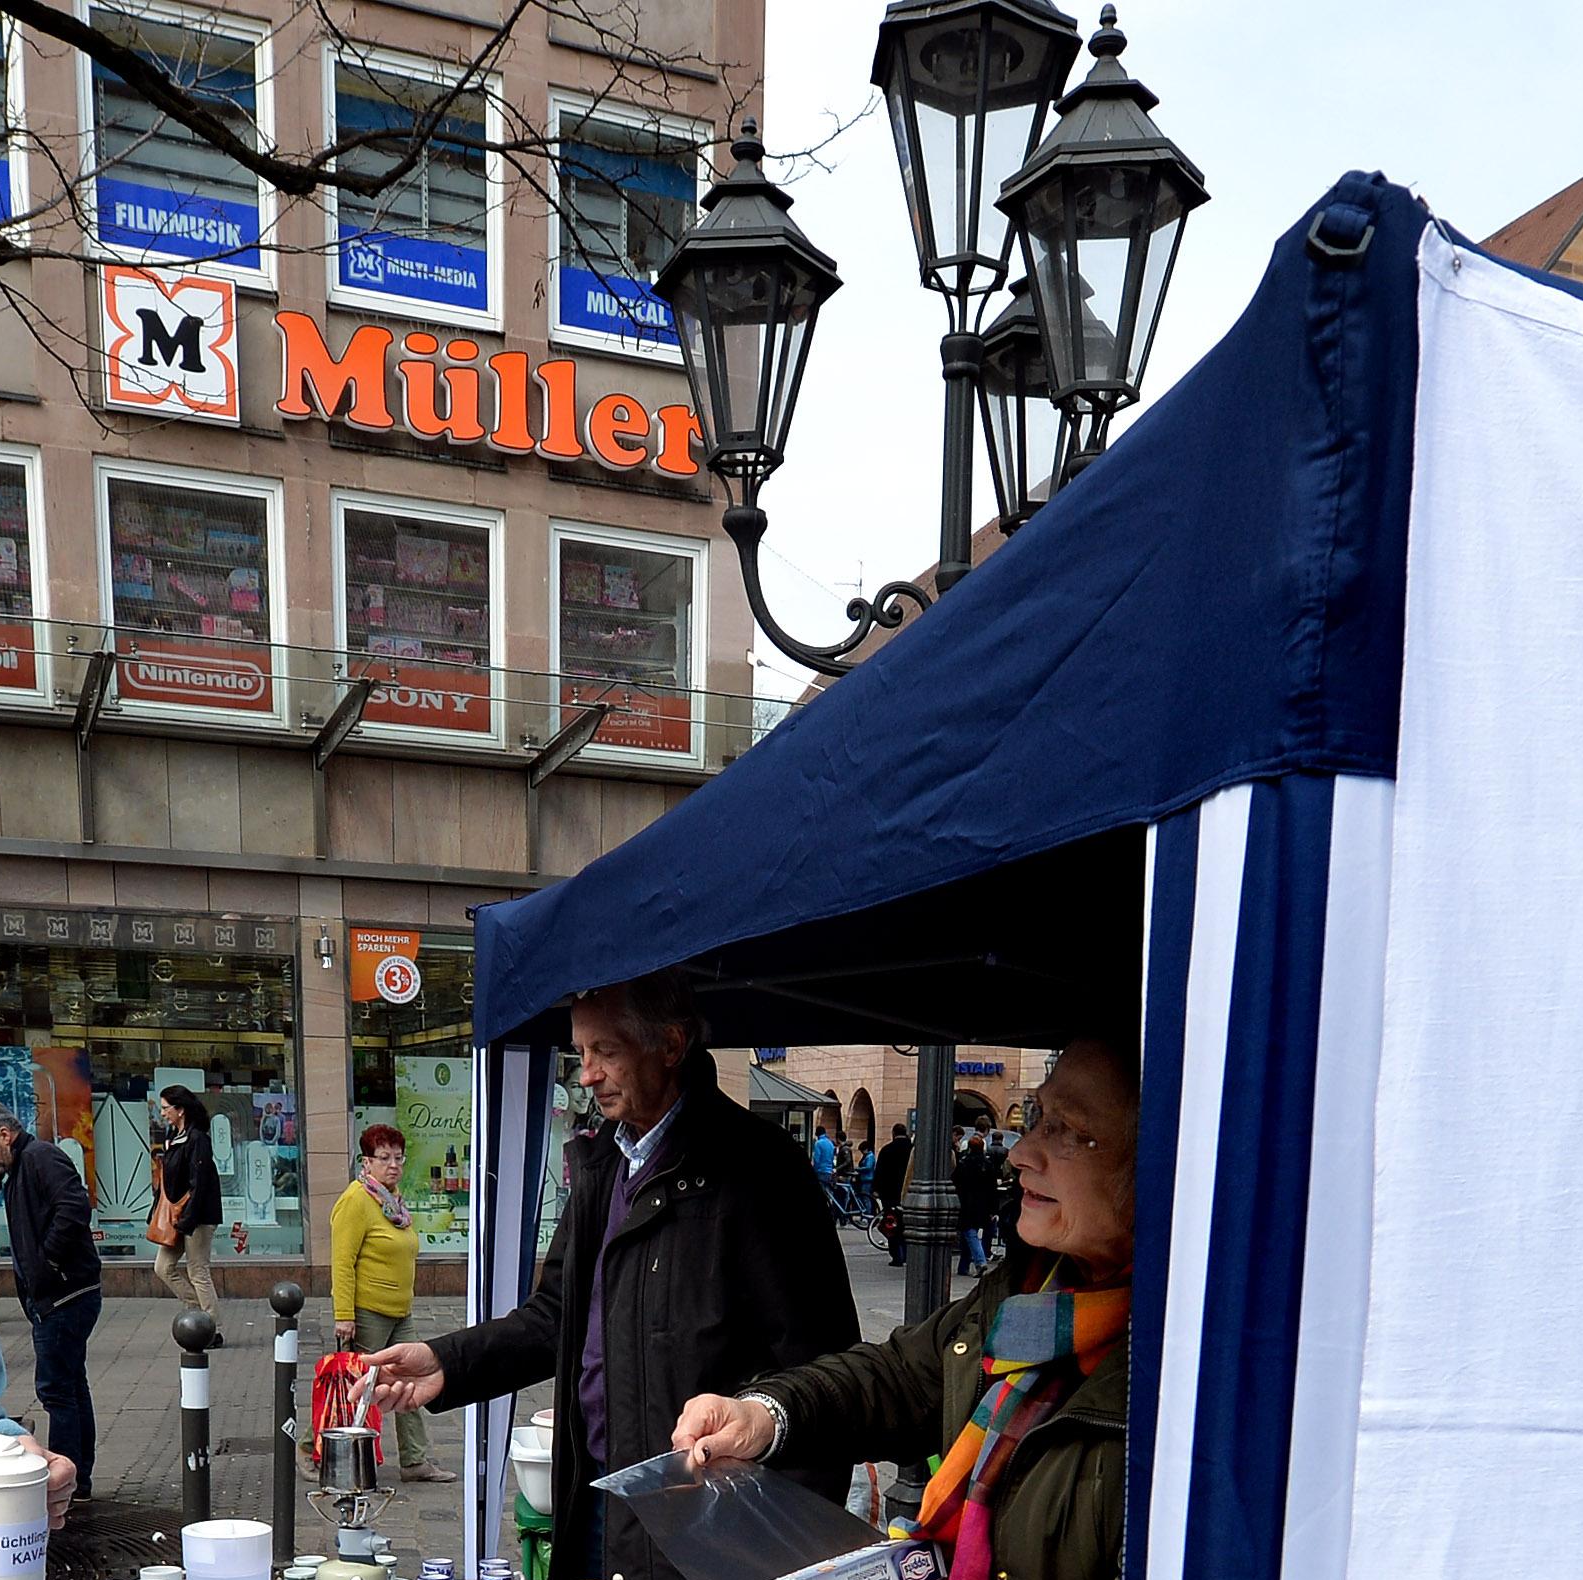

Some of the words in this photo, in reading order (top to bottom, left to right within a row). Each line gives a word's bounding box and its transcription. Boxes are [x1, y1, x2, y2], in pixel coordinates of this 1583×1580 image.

[114, 201, 243, 248] FILMMUSIK
[386, 258, 477, 290] MULTI-MEDIA
[585, 289, 668, 327] MUSICAL
[134, 308, 207, 375] M
[274, 309, 706, 480] Müller
[137, 662, 254, 691] Nintendo
[366, 686, 471, 713] SONY
[357, 934, 383, 943] NOCH
[384, 935, 411, 944] MEHR
[357, 943, 391, 953] SPAREN
[954, 1062, 1005, 1076] STADT
[11, 1547, 47, 1566] KAVA
